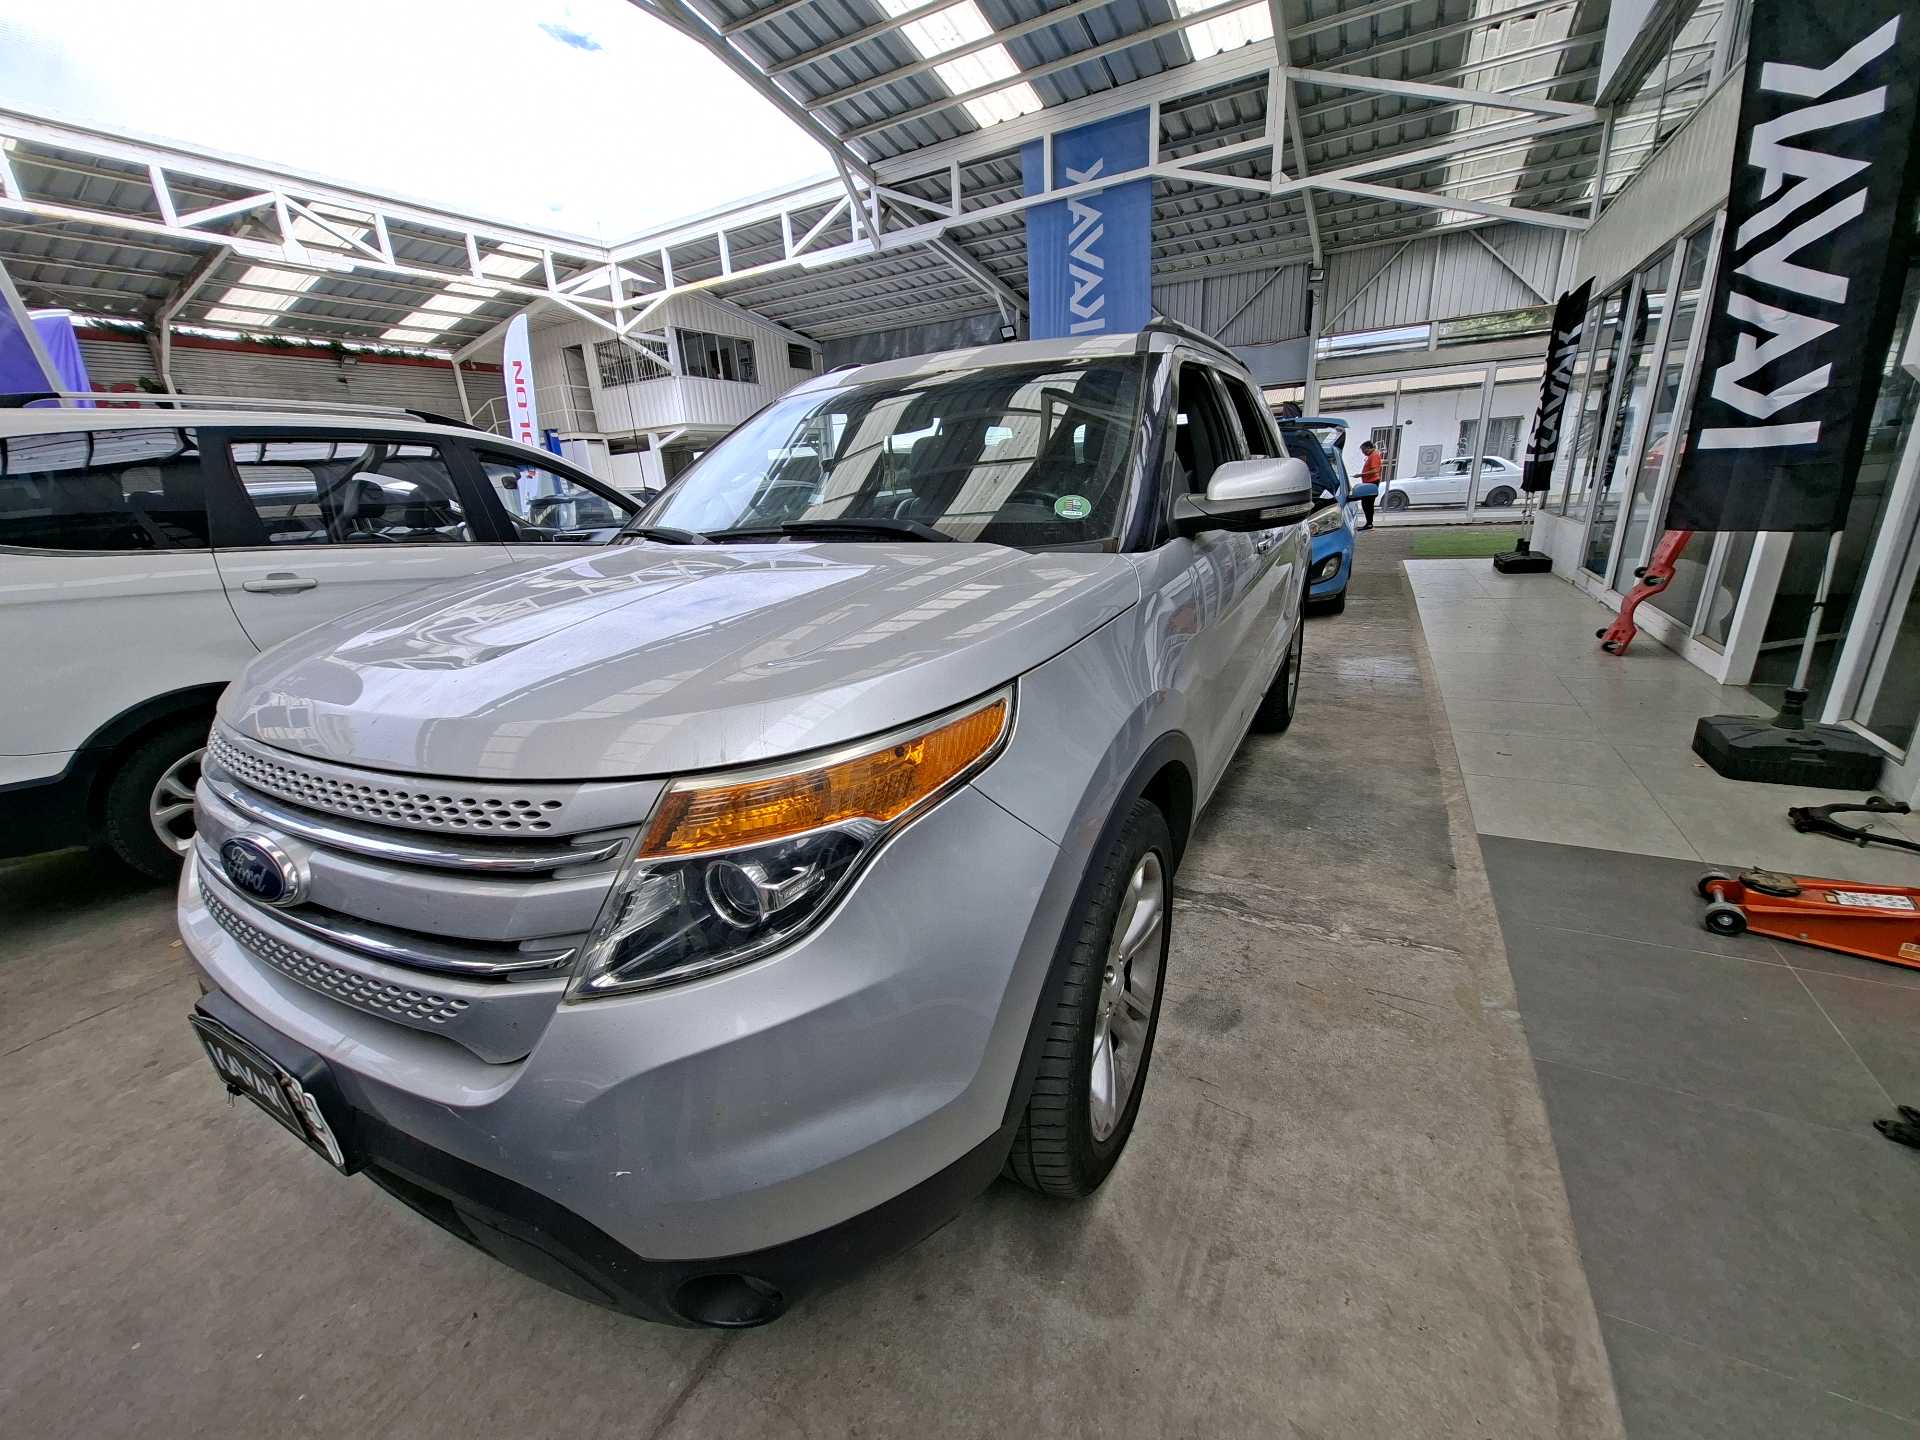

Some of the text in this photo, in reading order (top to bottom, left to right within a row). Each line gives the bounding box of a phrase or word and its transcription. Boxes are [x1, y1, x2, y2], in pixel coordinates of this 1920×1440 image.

[1066, 158, 1105, 334] KAVAK
[1698, 14, 1900, 449] KAVAK
[1524, 322, 1583, 462] KAVAK
[228, 846, 267, 892] Ford
